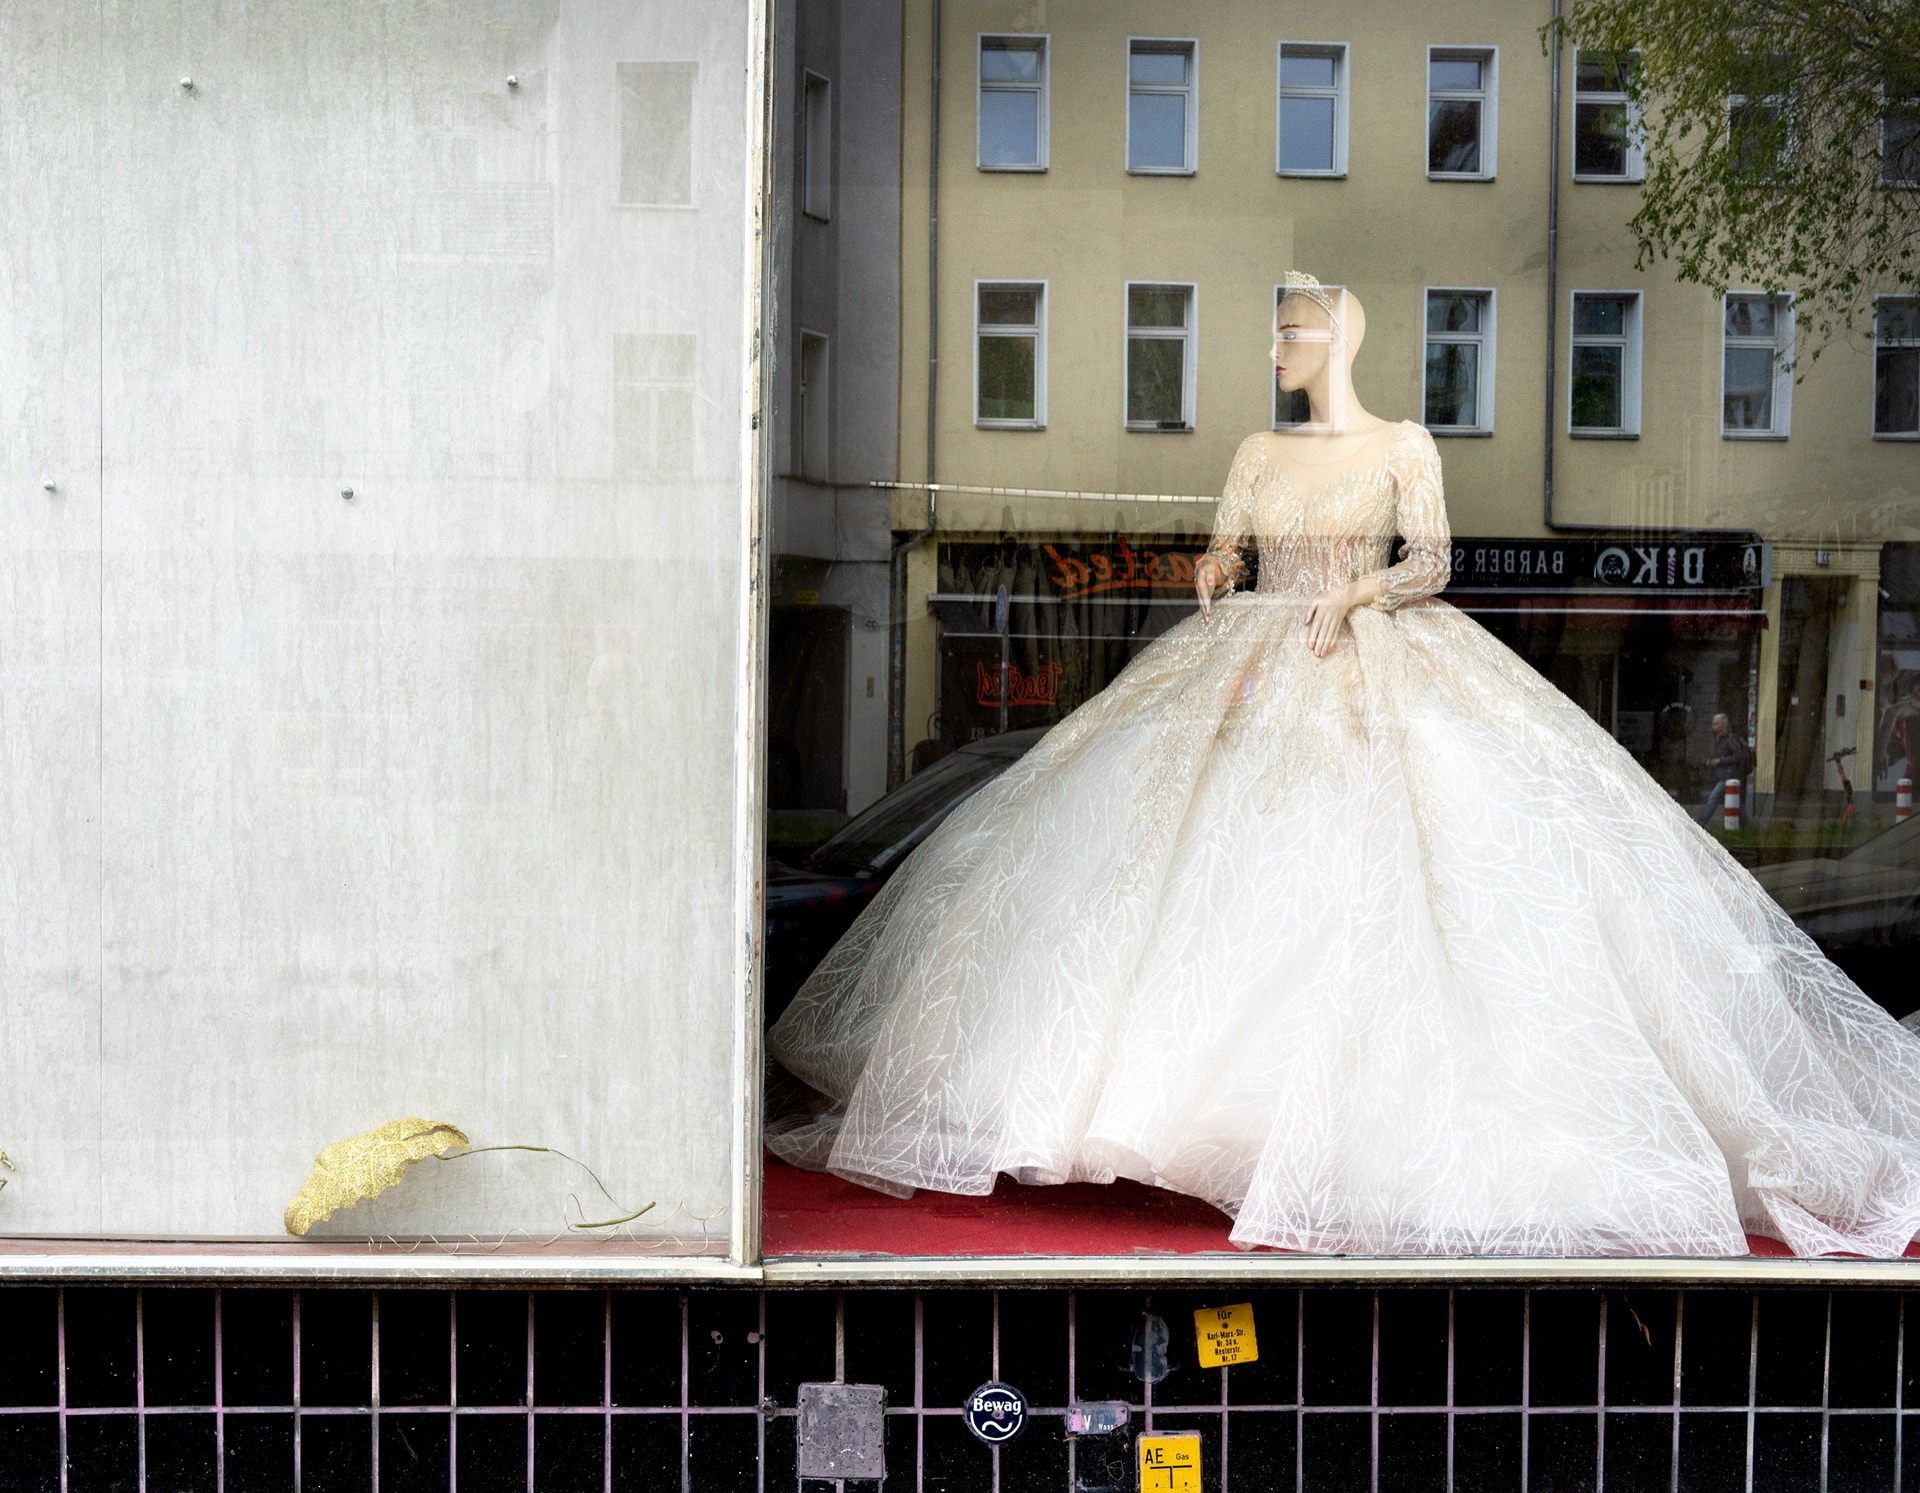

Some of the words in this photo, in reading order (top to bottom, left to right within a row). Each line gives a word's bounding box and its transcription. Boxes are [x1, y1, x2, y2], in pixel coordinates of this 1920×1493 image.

[1217, 1310, 1232, 1320] für
[1207, 1328, 1246, 1340] Karl-Marx-Str.
[1214, 1346, 1242, 1355] Reuterstr.
[973, 1398, 1022, 1415] Bewag
[1098, 1423, 1118, 1431] Wass
[1144, 1448, 1164, 1464] AE
[1175, 1452, 1189, 1460] Gas
